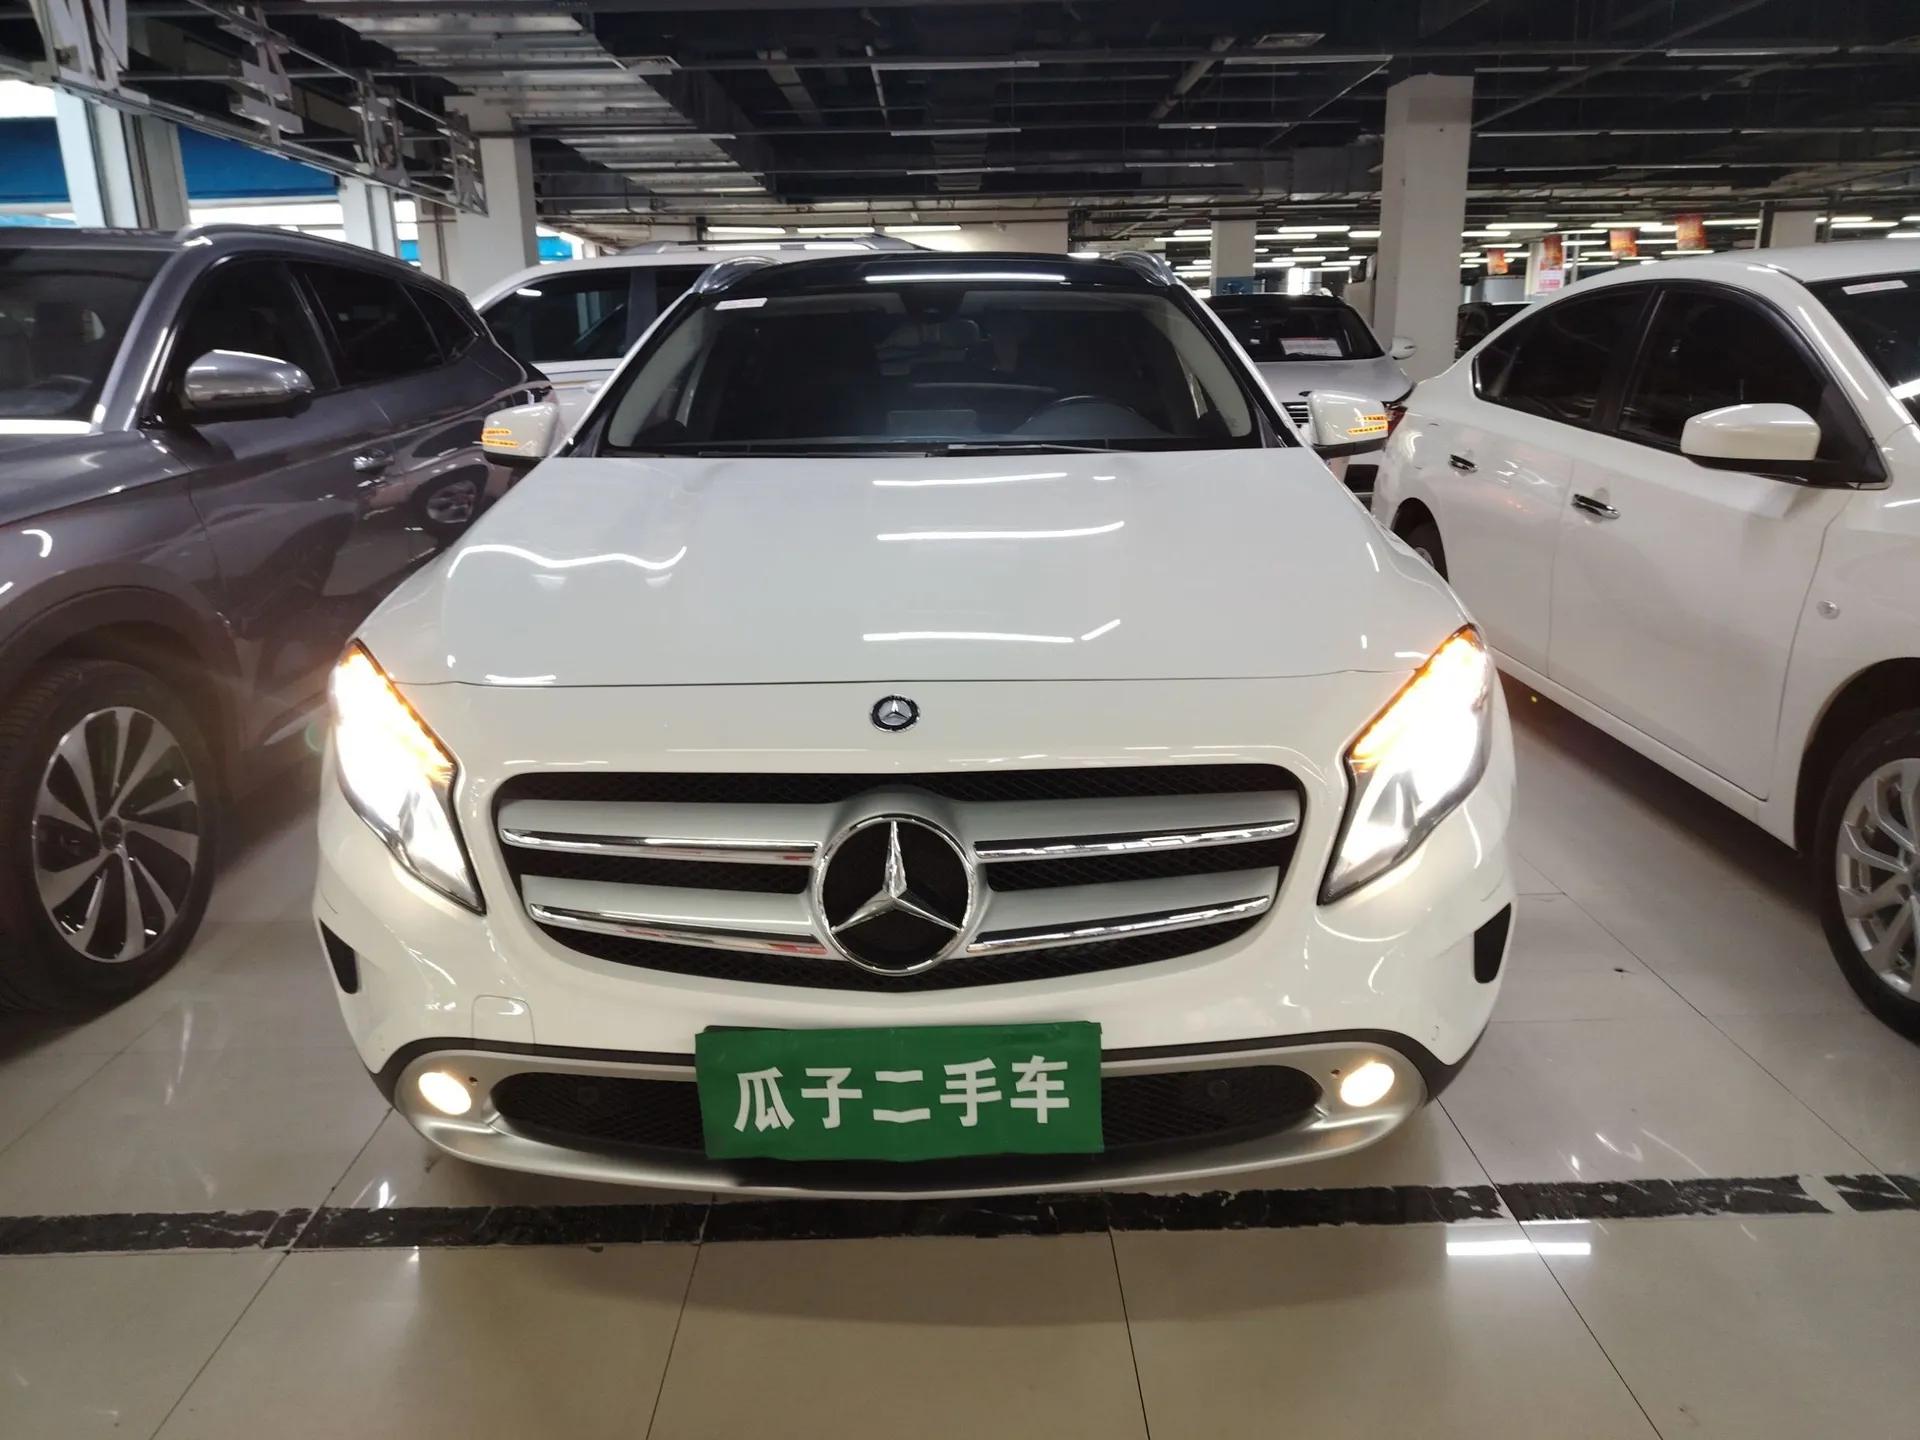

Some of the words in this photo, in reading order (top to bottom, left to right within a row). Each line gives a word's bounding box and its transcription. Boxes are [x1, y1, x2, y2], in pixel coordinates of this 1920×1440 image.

[734, 1055, 1070, 1132] 瓜子二手车
